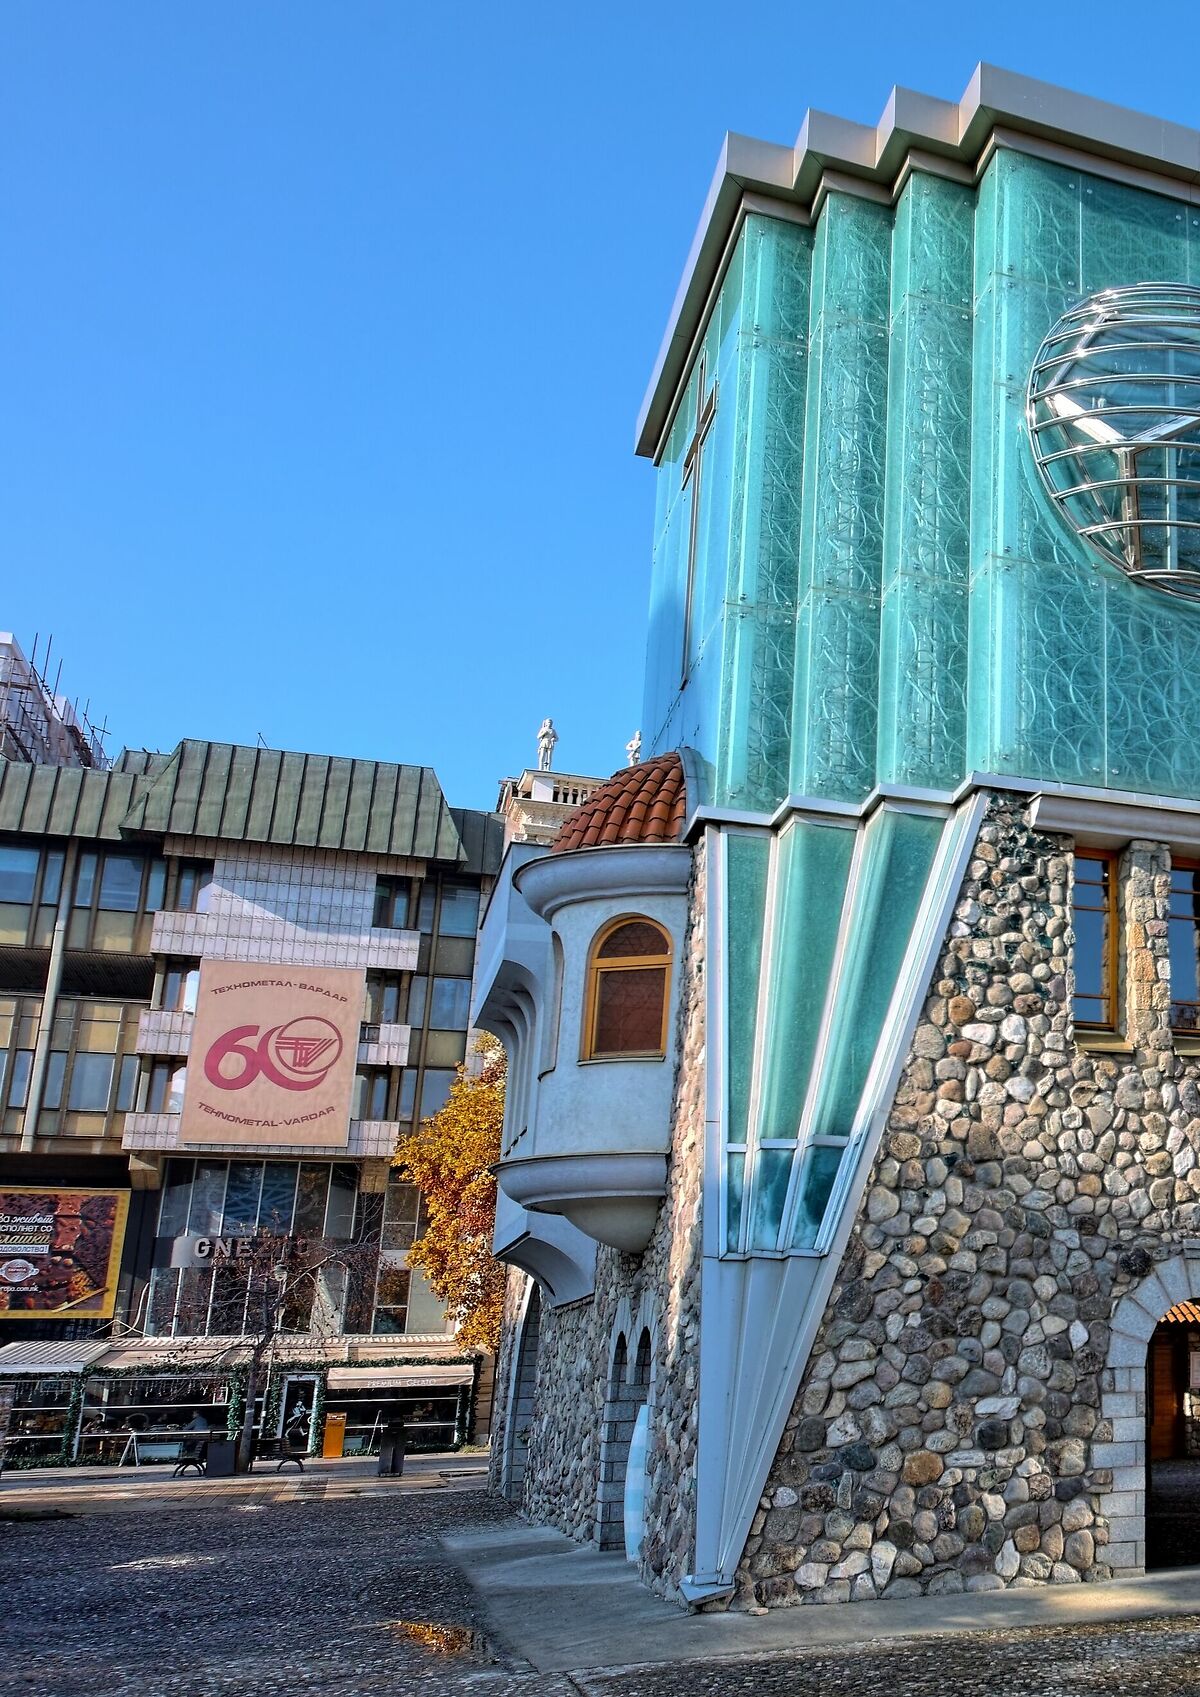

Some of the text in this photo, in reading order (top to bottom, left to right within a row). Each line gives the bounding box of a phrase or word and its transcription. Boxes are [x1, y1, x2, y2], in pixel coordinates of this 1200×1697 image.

[211, 980, 348, 1003] ТЕХНОМЕТАЛ-ВАРДАР
[198, 1102, 335, 1127] TEHNOMETAL-VARDAR
[0, 1224, 39, 1232] сполнет
